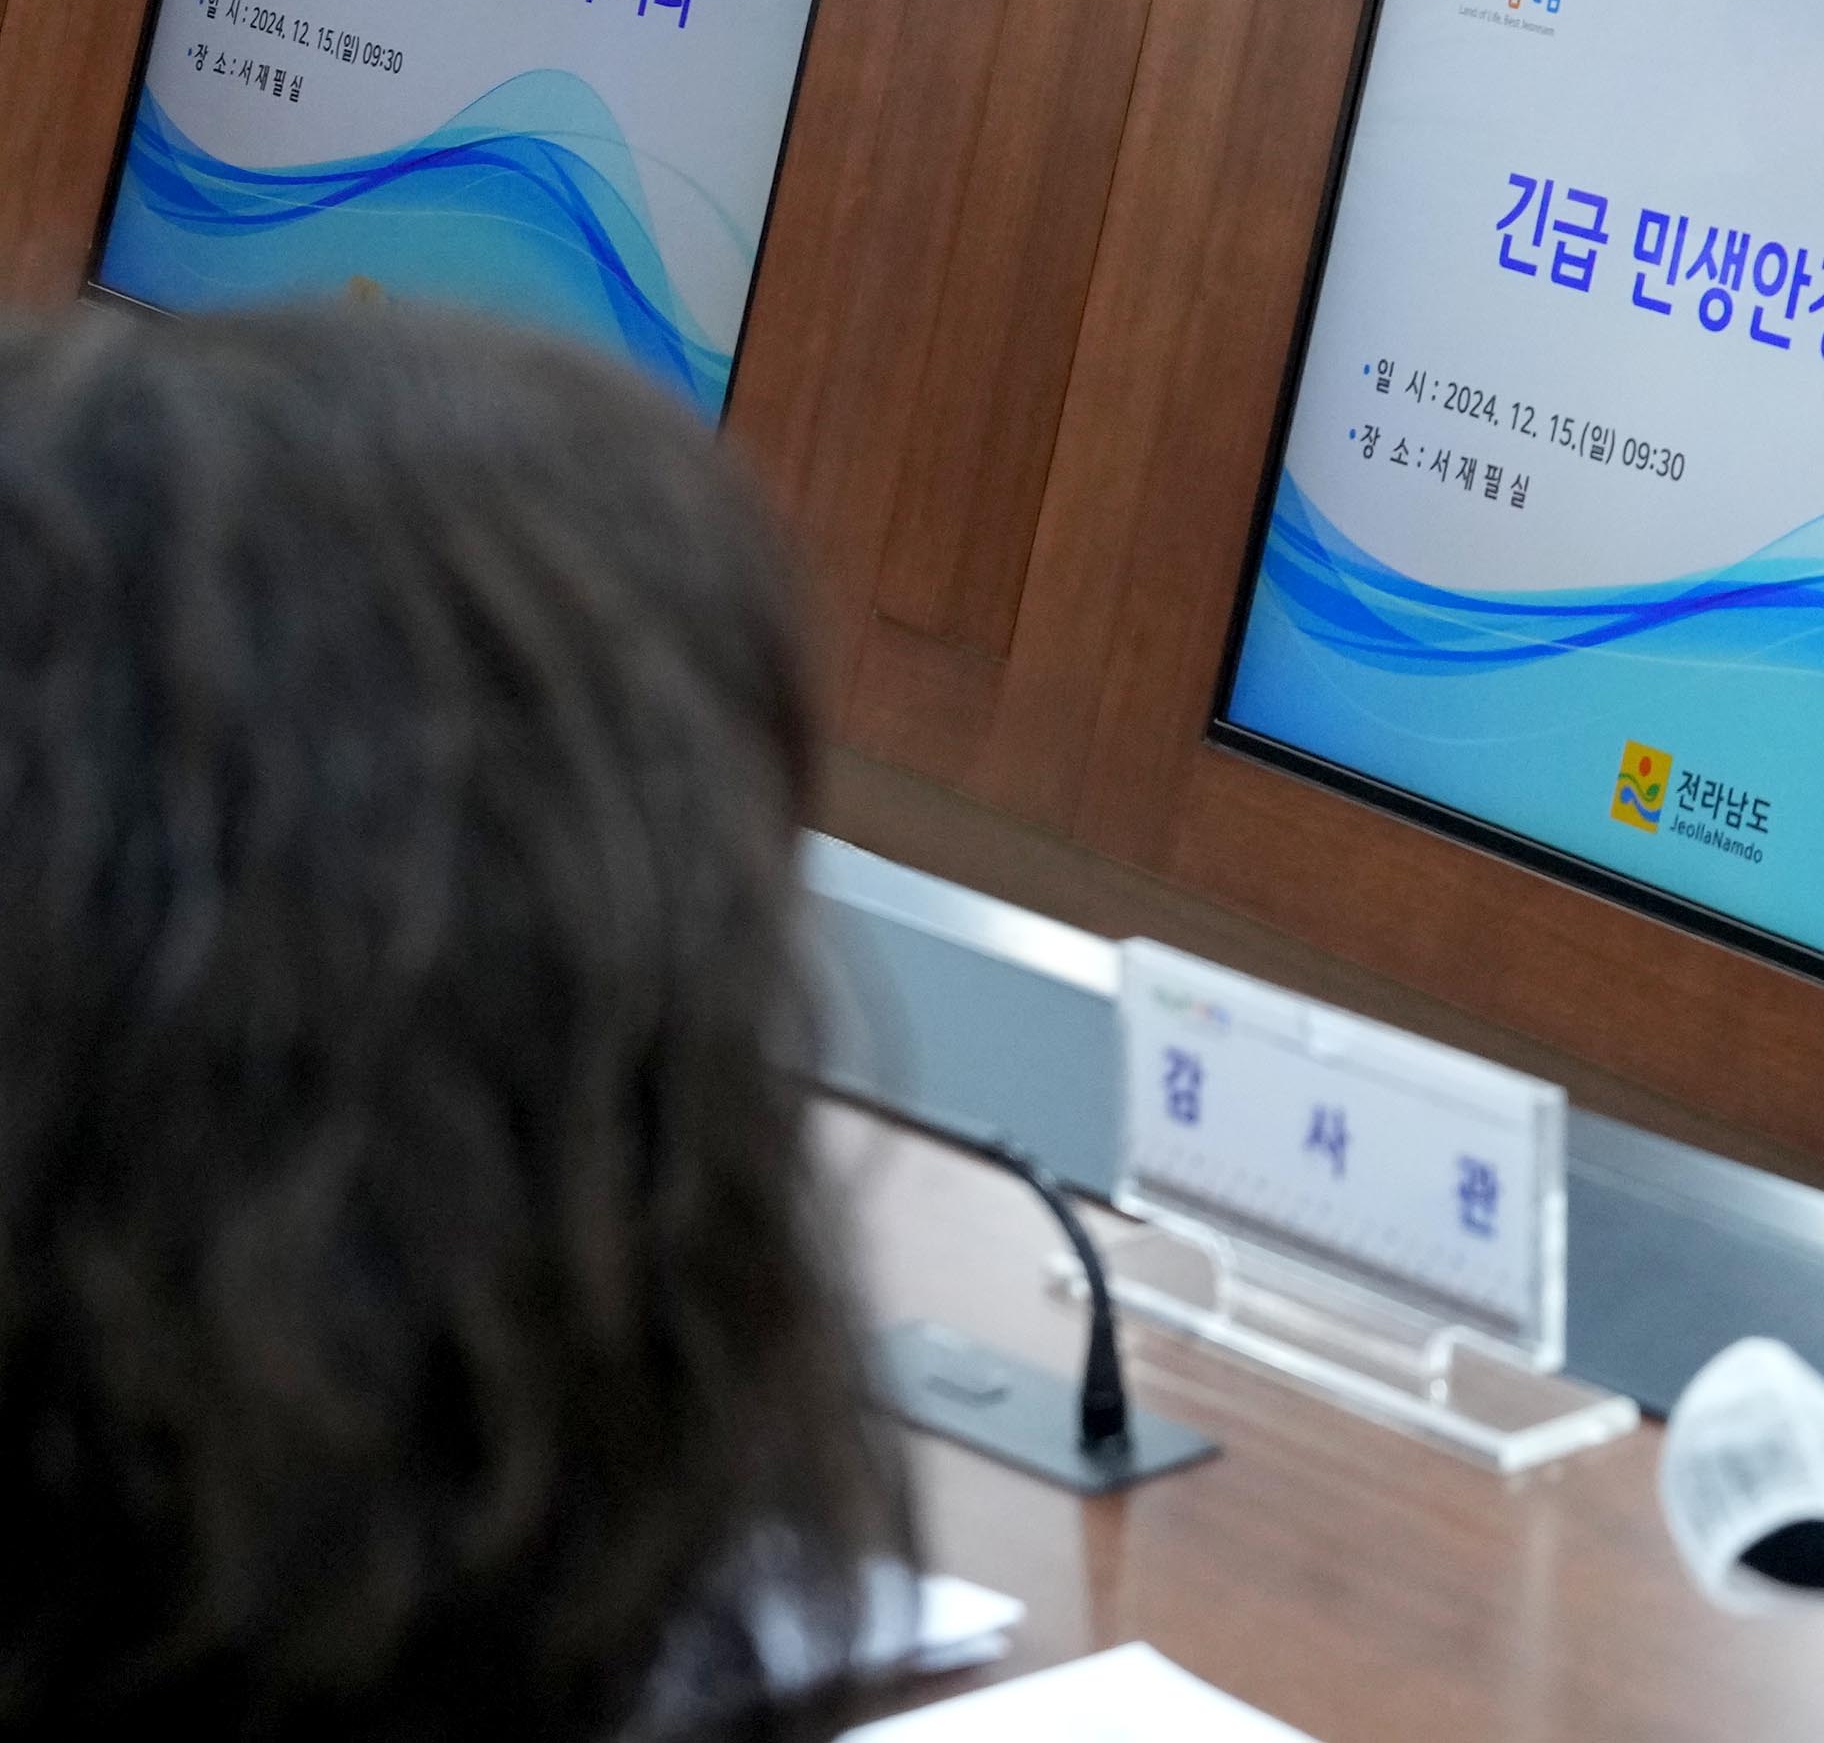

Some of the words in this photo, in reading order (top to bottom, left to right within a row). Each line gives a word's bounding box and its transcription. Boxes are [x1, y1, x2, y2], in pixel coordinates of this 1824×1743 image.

[249, 7, 286, 39] 2024.
[293, 20, 310, 47] 12.
[363, 42, 403, 74] 09:30
[1496, 173, 1608, 292] 긴급
[1443, 382, 1499, 426] 2024.
[1511, 402, 1537, 438] 12.
[1622, 437, 1685, 481] 09:30
[1677, 770, 1771, 833] 전라남도
[1670, 814, 1763, 864] JeollaNamdo
